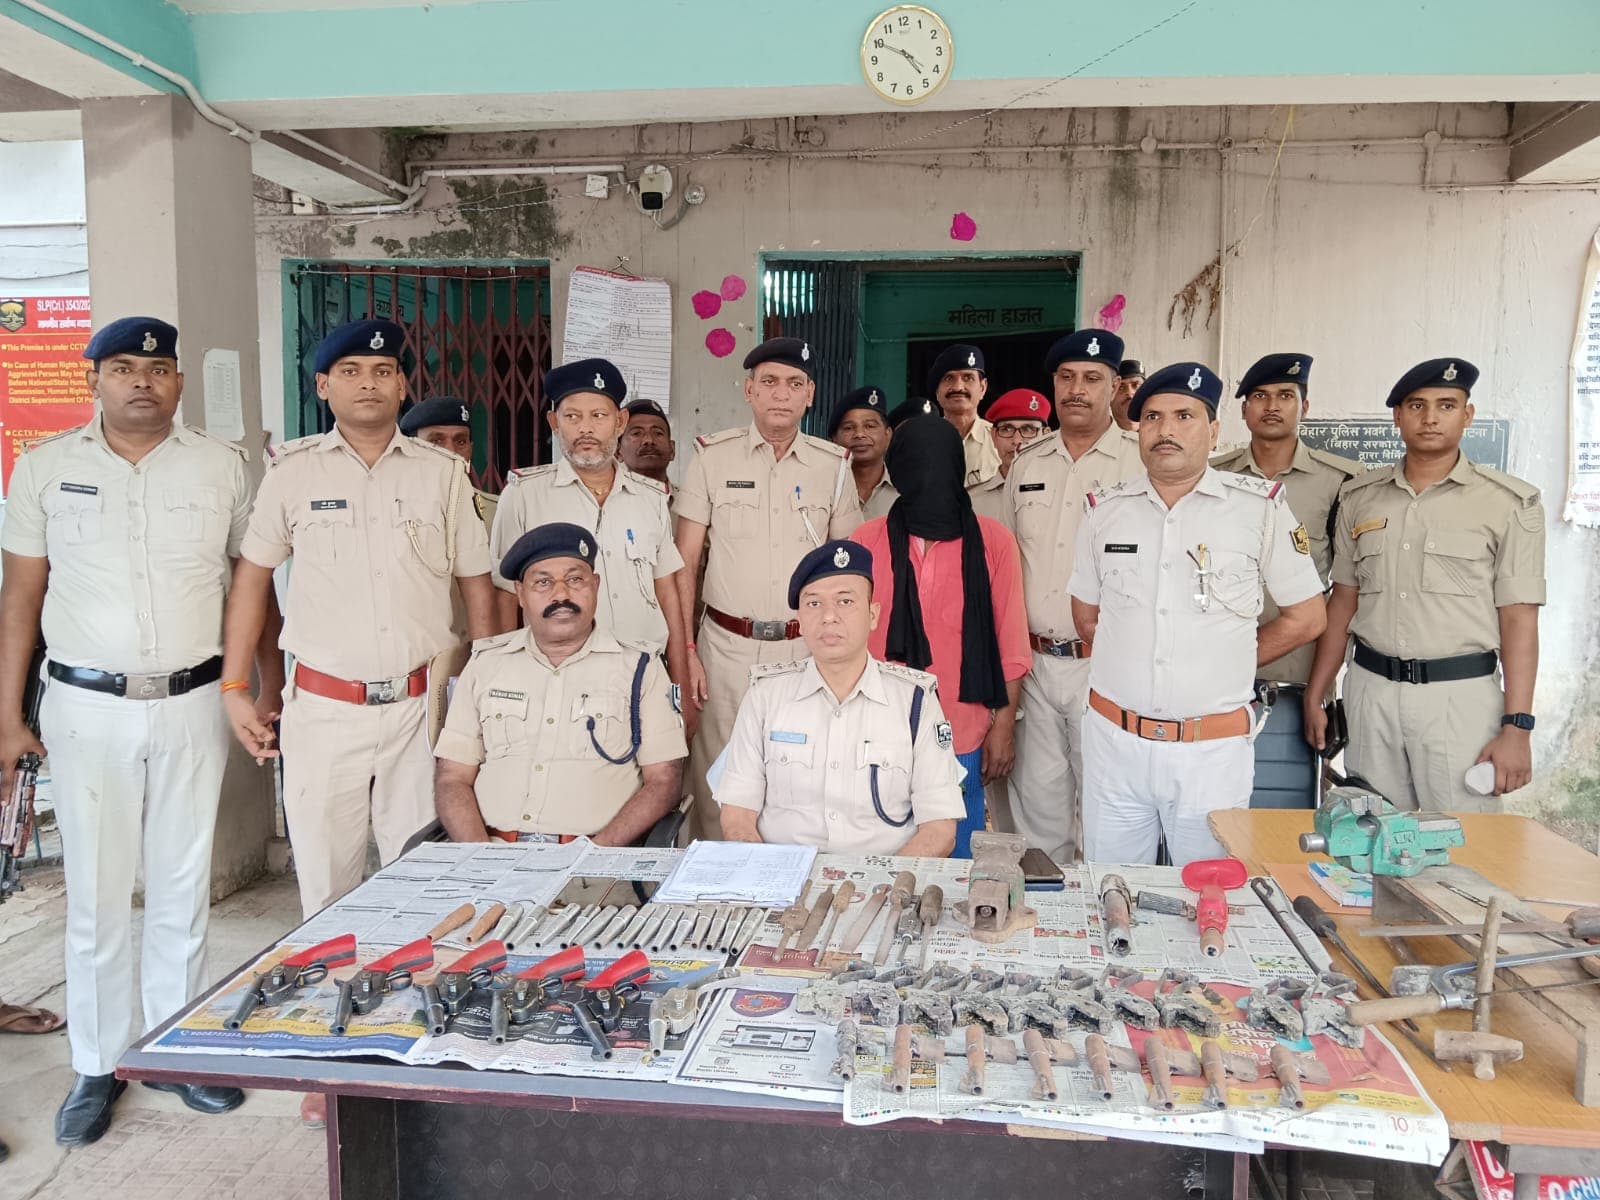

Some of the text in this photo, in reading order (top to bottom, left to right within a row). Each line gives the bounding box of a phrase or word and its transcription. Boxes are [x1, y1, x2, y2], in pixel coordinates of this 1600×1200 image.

[898, 16, 909, 26] 12
[918, 19, 922, 29] 1
[884, 24, 893, 34] 11
[930, 29, 938, 40] 2
[874, 38, 884, 49] 10
[936, 46, 943, 57] 3
[871, 55, 879, 66] 9
[932, 64, 940, 74] 4
[877, 72, 884, 82] 8
[890, 83, 898, 94] 7
[922, 78, 930, 88] 5
[906, 85, 914, 95] 6
[948, 304, 1044, 326] महिला हाजत
[1298, 424, 1328, 439] बिहार
[1330, 424, 1360, 439] पुलिस
[1363, 426, 1387, 437] भवन
[1391, 1117, 1409, 1132] 10
